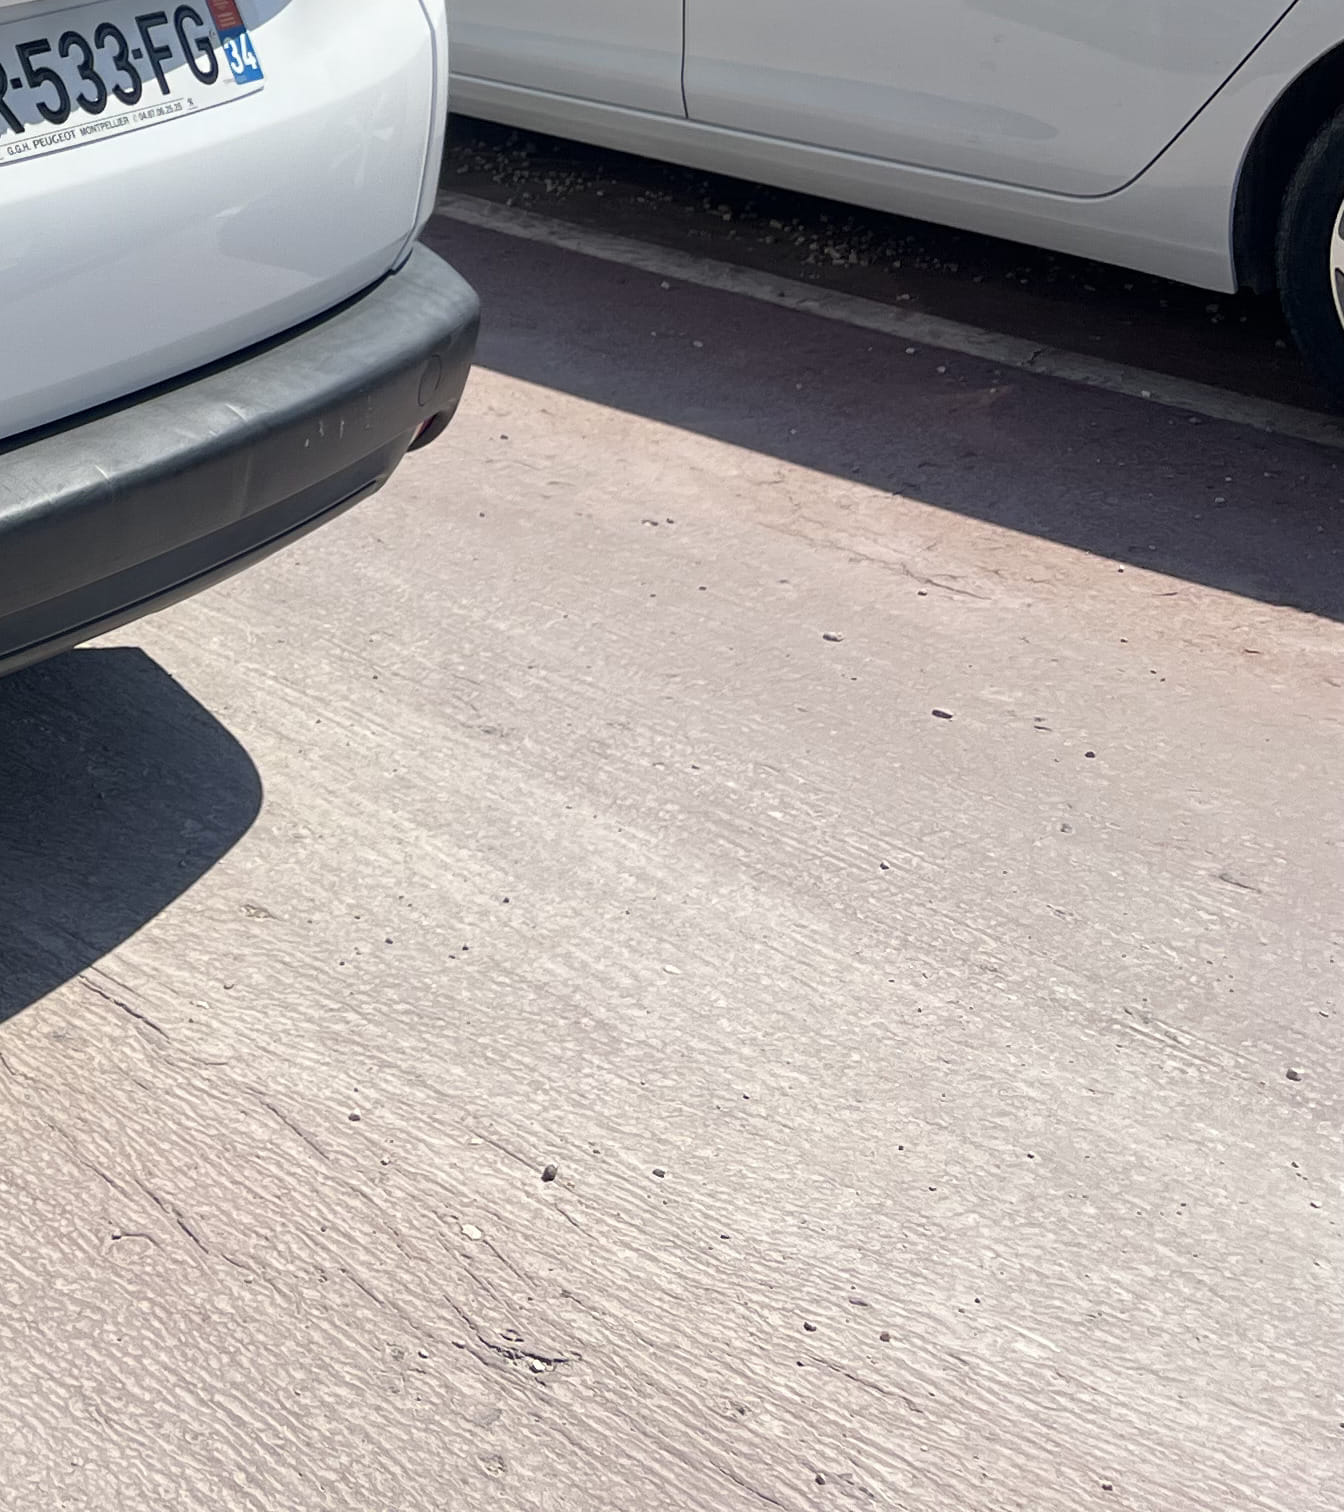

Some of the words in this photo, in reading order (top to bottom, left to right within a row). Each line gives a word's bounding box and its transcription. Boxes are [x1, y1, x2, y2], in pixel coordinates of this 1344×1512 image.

[223, 33, 258, 75] 34
[32, 130, 76, 150] PEUGEOT
[79, 115, 129, 136] MONTPELLIER
